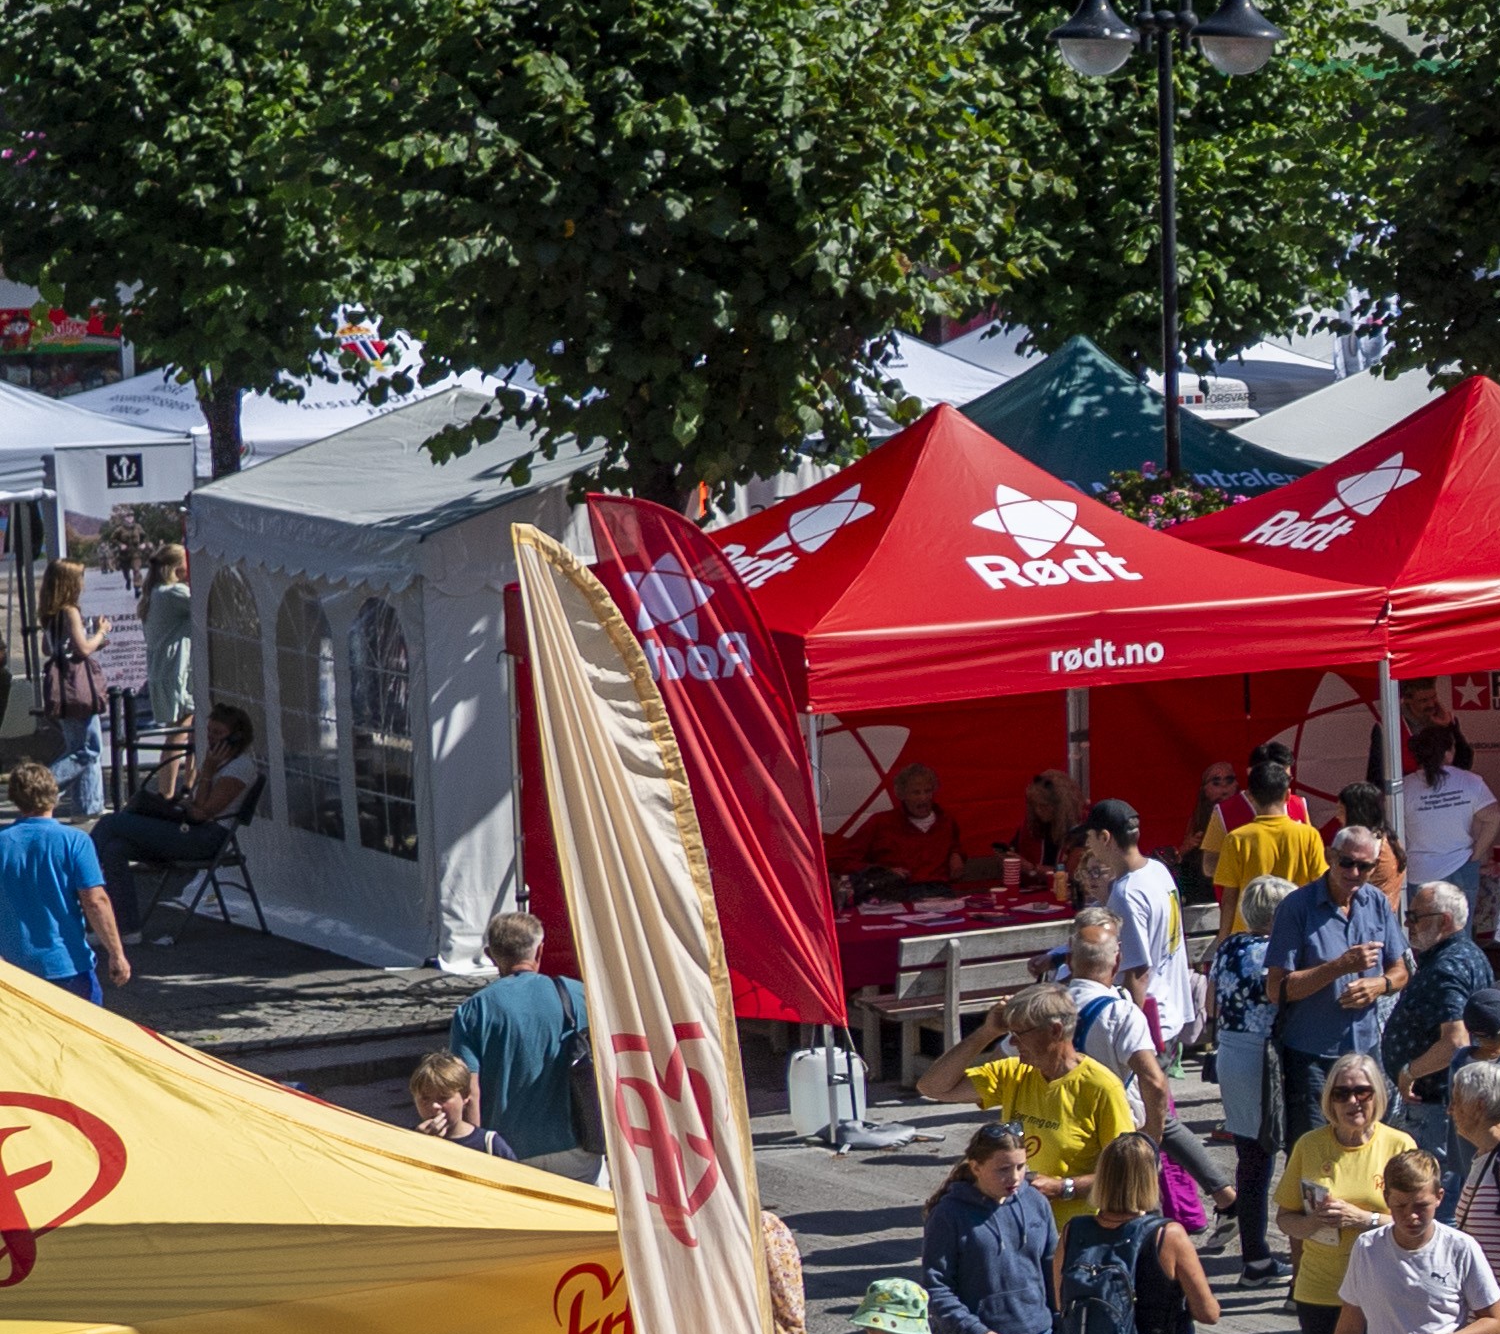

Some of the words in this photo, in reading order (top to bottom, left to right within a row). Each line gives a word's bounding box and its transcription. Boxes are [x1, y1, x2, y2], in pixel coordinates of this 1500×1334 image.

[1242, 510, 1355, 552] Rødt
[965, 549, 1145, 590] Rødt
[1050, 639, 1166, 673] rødt.no
